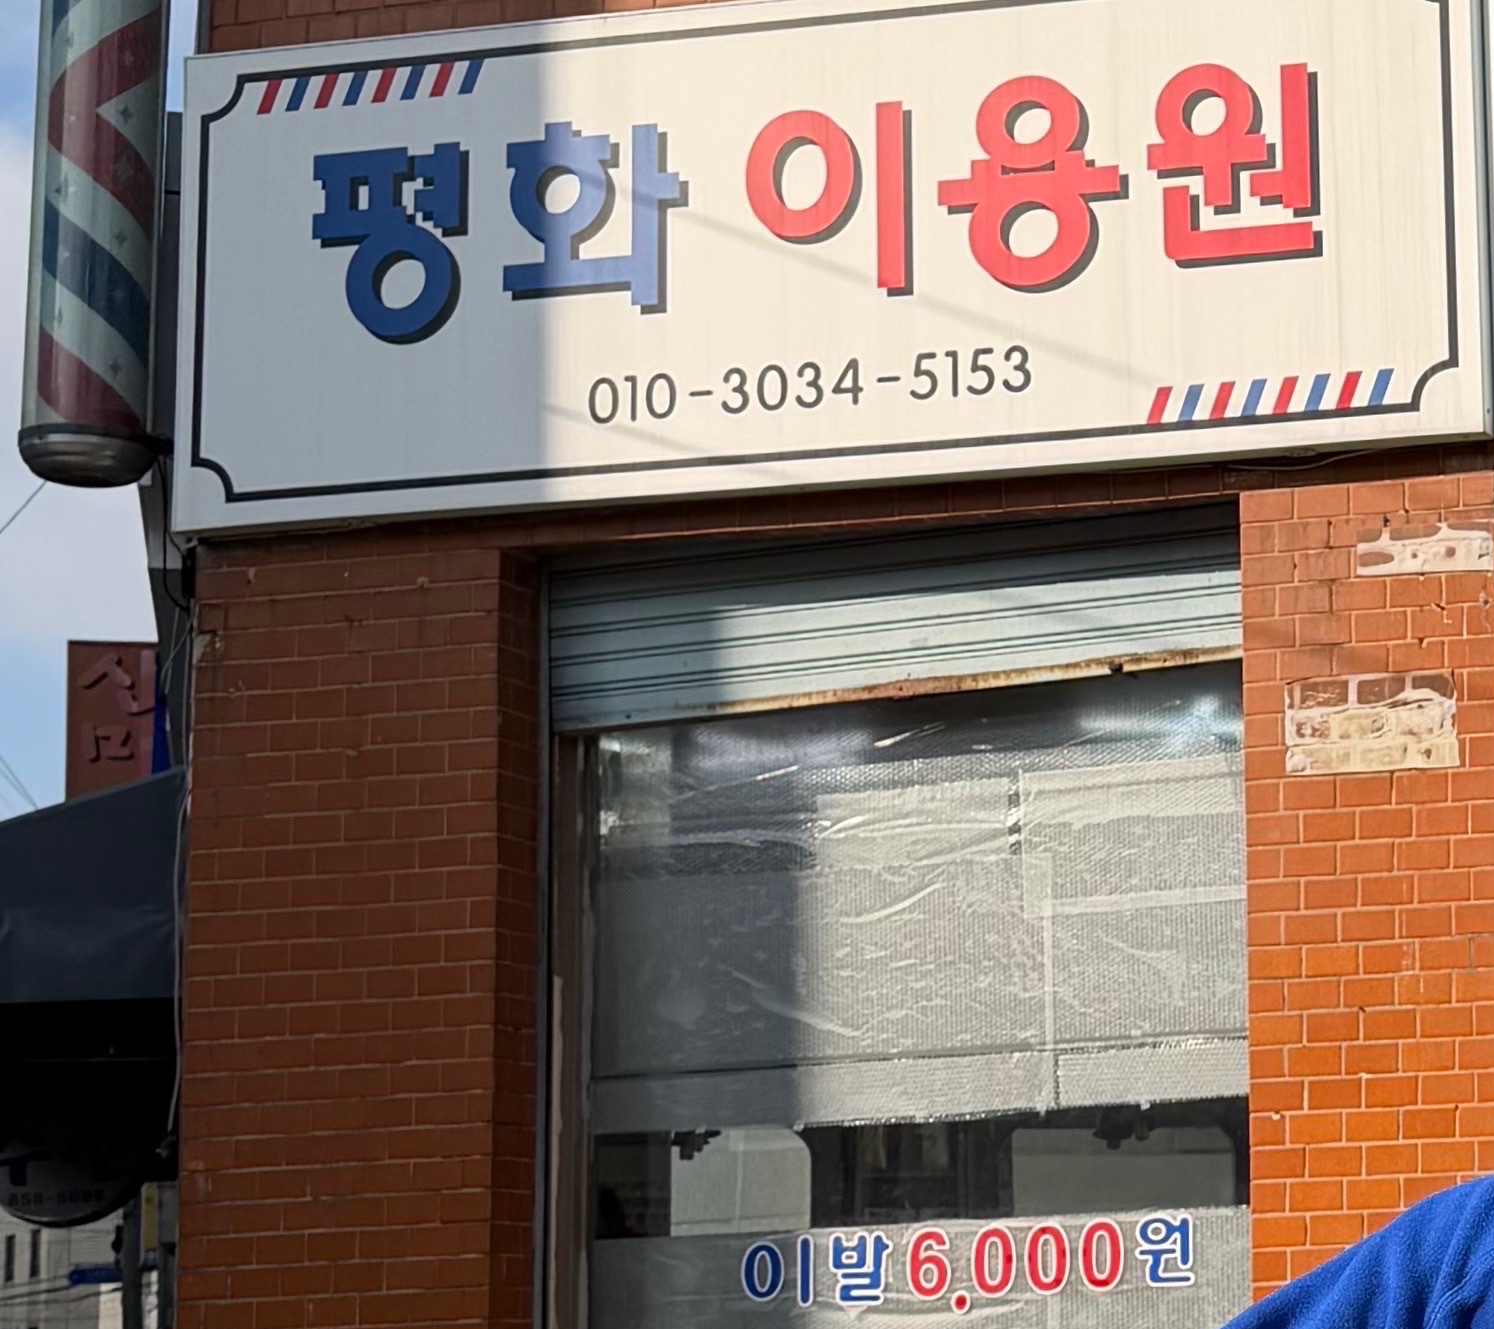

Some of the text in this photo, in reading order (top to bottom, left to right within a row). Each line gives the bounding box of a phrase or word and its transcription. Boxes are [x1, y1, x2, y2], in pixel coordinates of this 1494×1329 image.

[312, 62, 1324, 345] 평화 이용원
[587, 344, 1033, 425] 010-3034-5153
[740, 1230, 892, 1307] 이발
